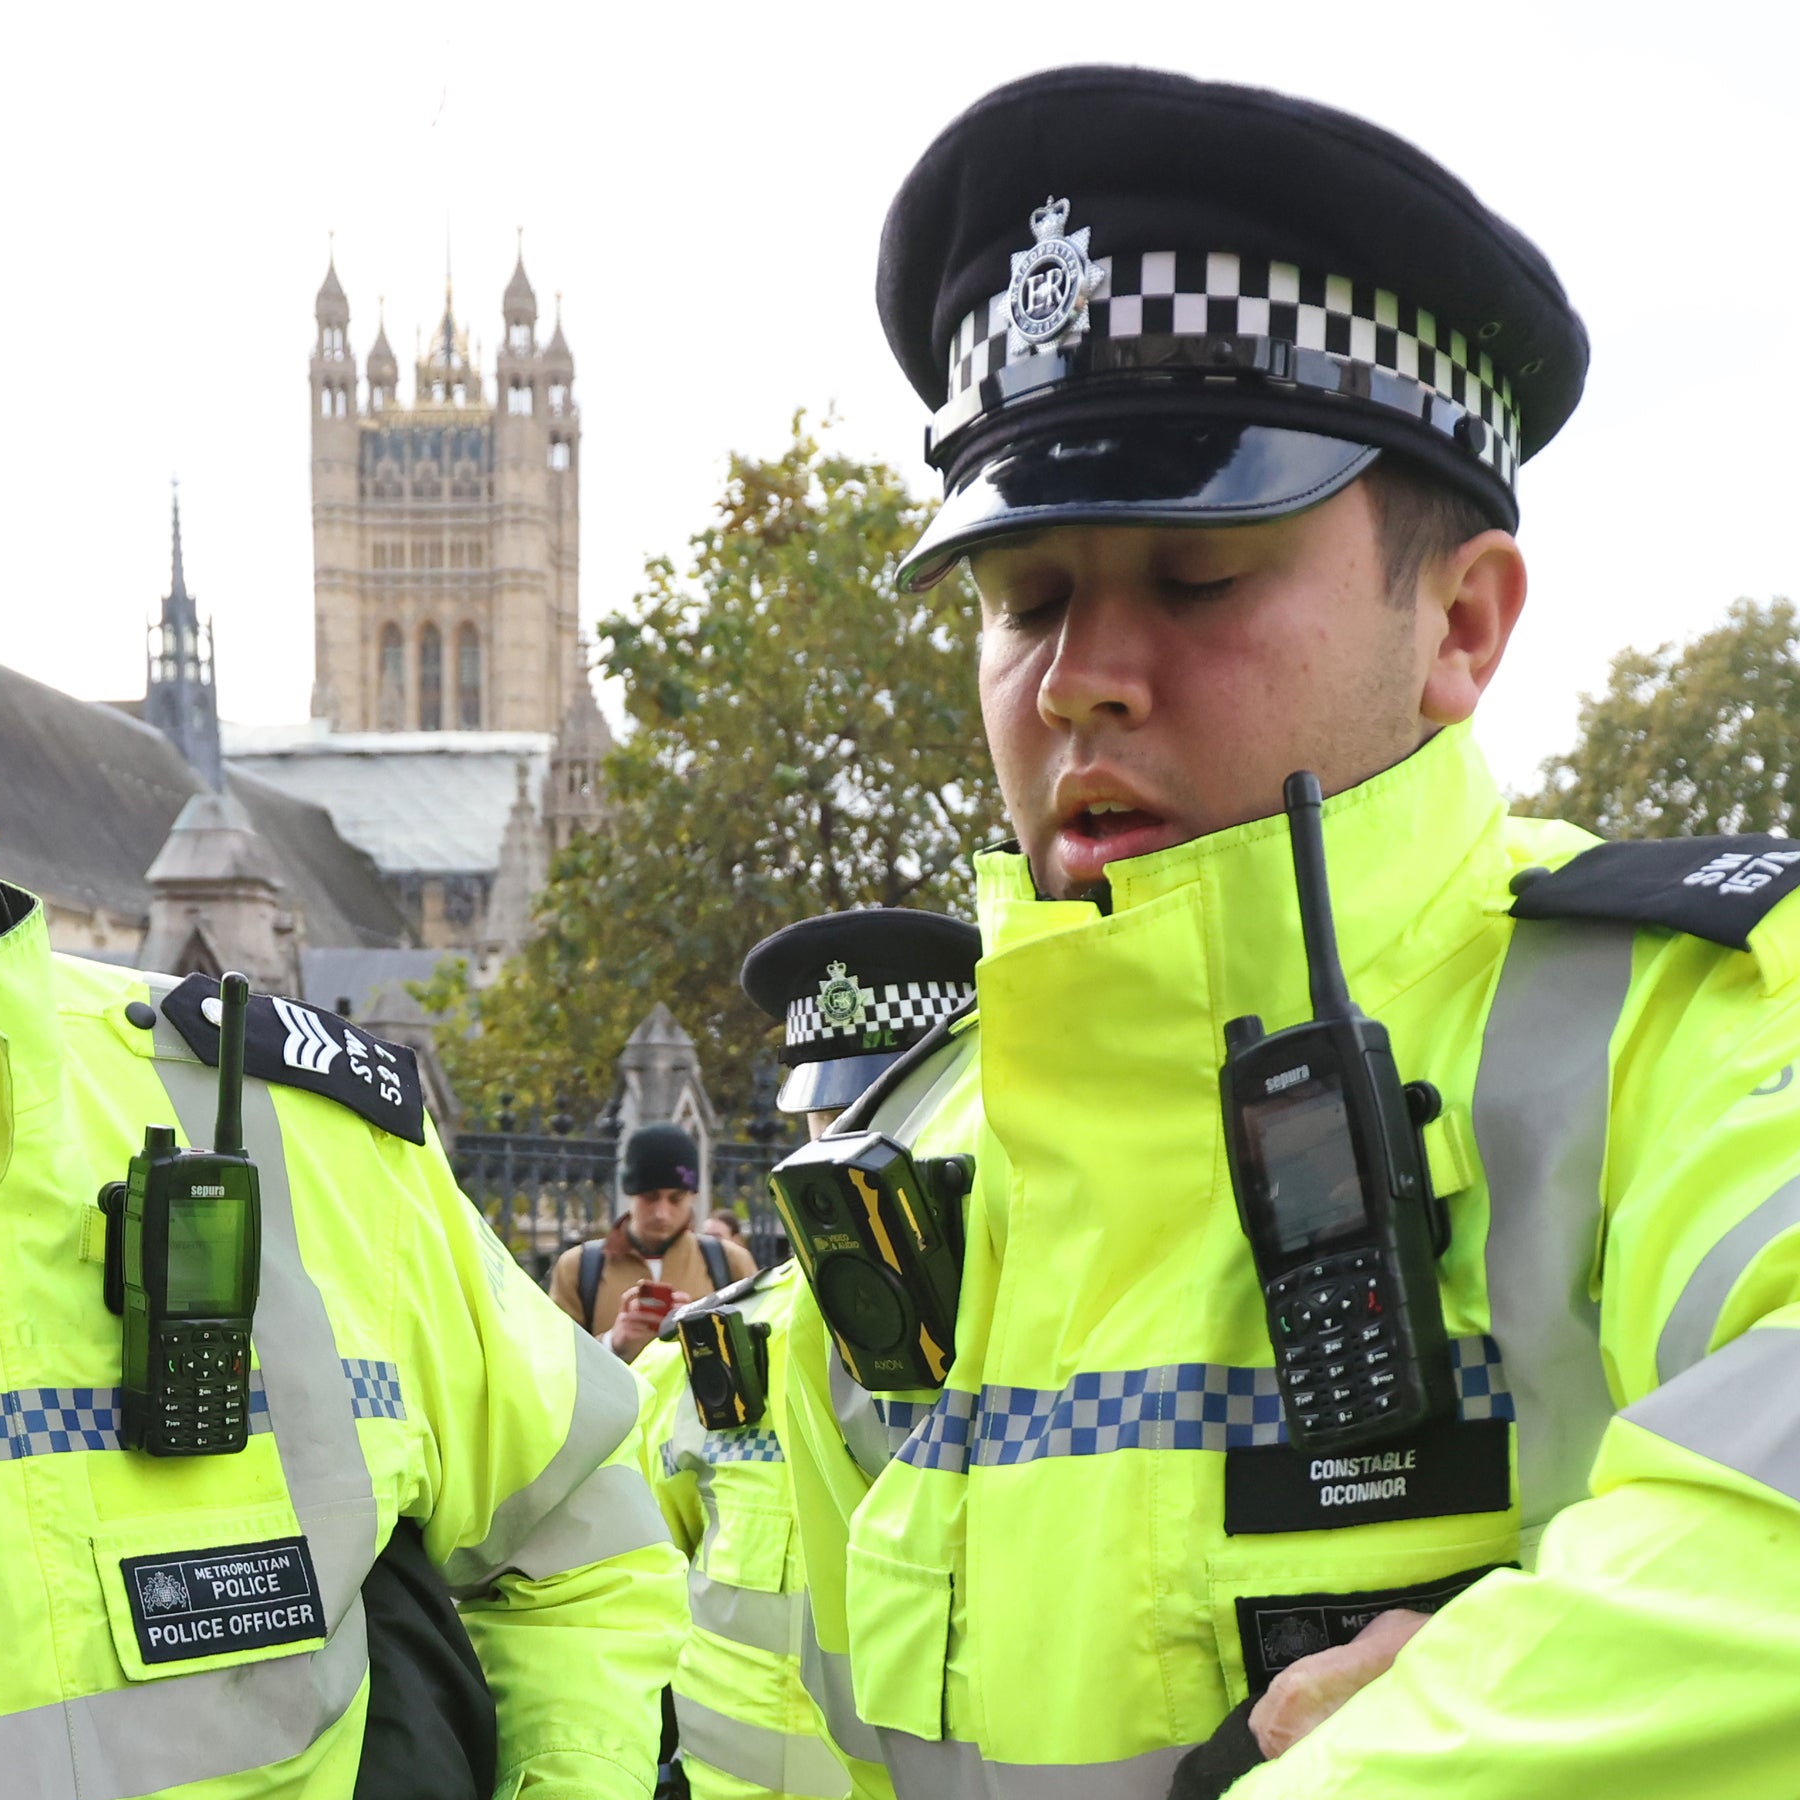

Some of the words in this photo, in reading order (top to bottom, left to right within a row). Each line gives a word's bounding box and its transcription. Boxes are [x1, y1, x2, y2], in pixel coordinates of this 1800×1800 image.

[343, 1029, 373, 1084] SW
[190, 1185, 225, 1197] sepura
[1309, 1449, 1417, 1481] CONSTABLE
[1320, 1476, 1407, 1507] OCONNOR
[194, 1555, 291, 1581] METROPOLITAN
[211, 1573, 281, 1600] POLICE
[147, 1617, 225, 1647] POLICE
[229, 1604, 315, 1636] OFFICER
